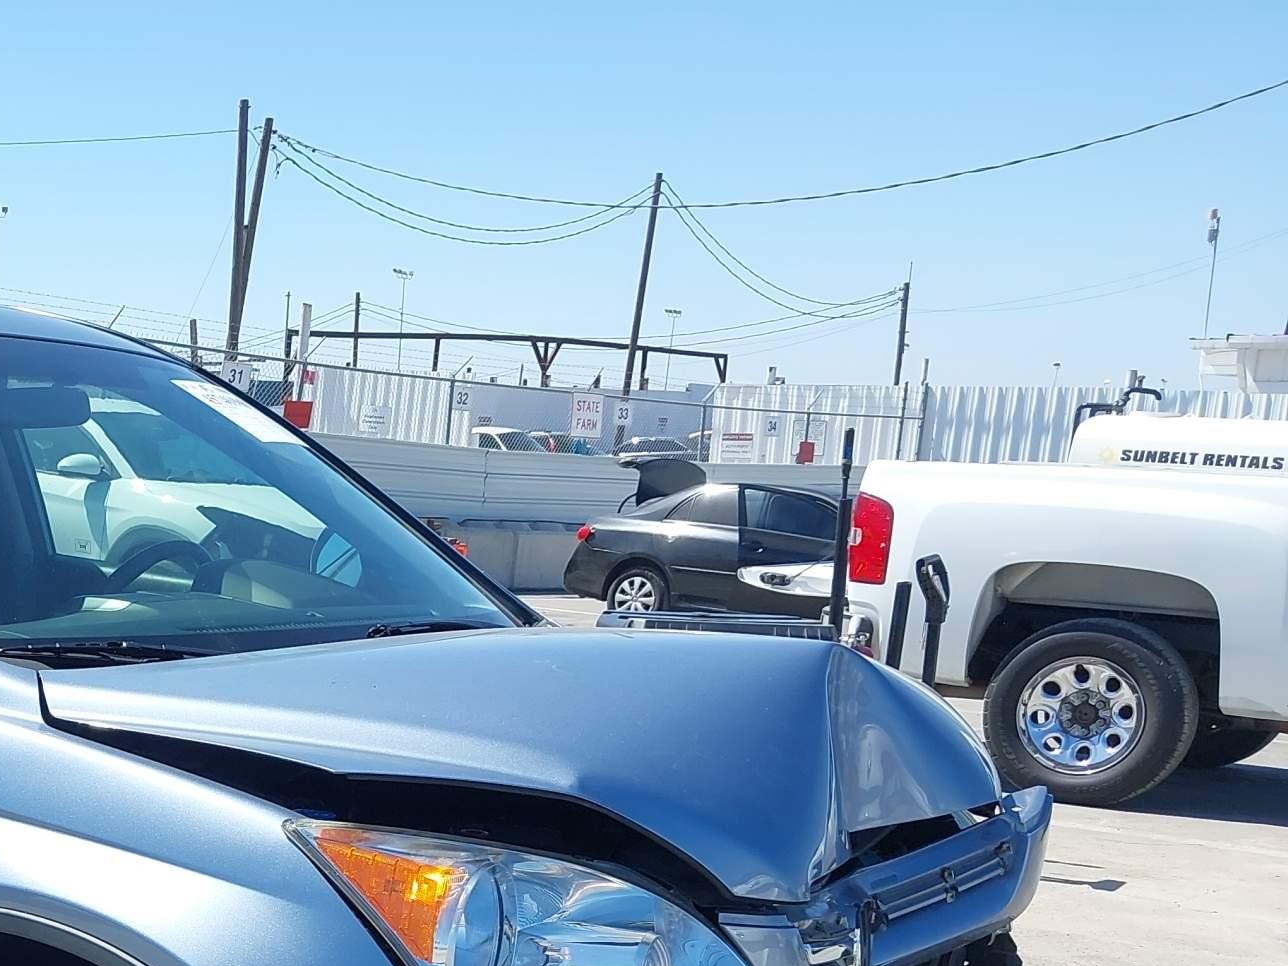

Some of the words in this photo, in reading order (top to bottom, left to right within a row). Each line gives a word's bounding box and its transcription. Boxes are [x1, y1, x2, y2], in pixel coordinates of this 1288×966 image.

[228, 368, 244, 385] 31
[456, 391, 469, 405] 32
[575, 399, 600, 414] STATE
[617, 407, 629, 420] 33
[575, 418, 598, 431] FARM
[767, 421, 777, 432] 34
[1120, 449, 1199, 465] SUNBELT
[1202, 453, 1285, 470] RENTALS
